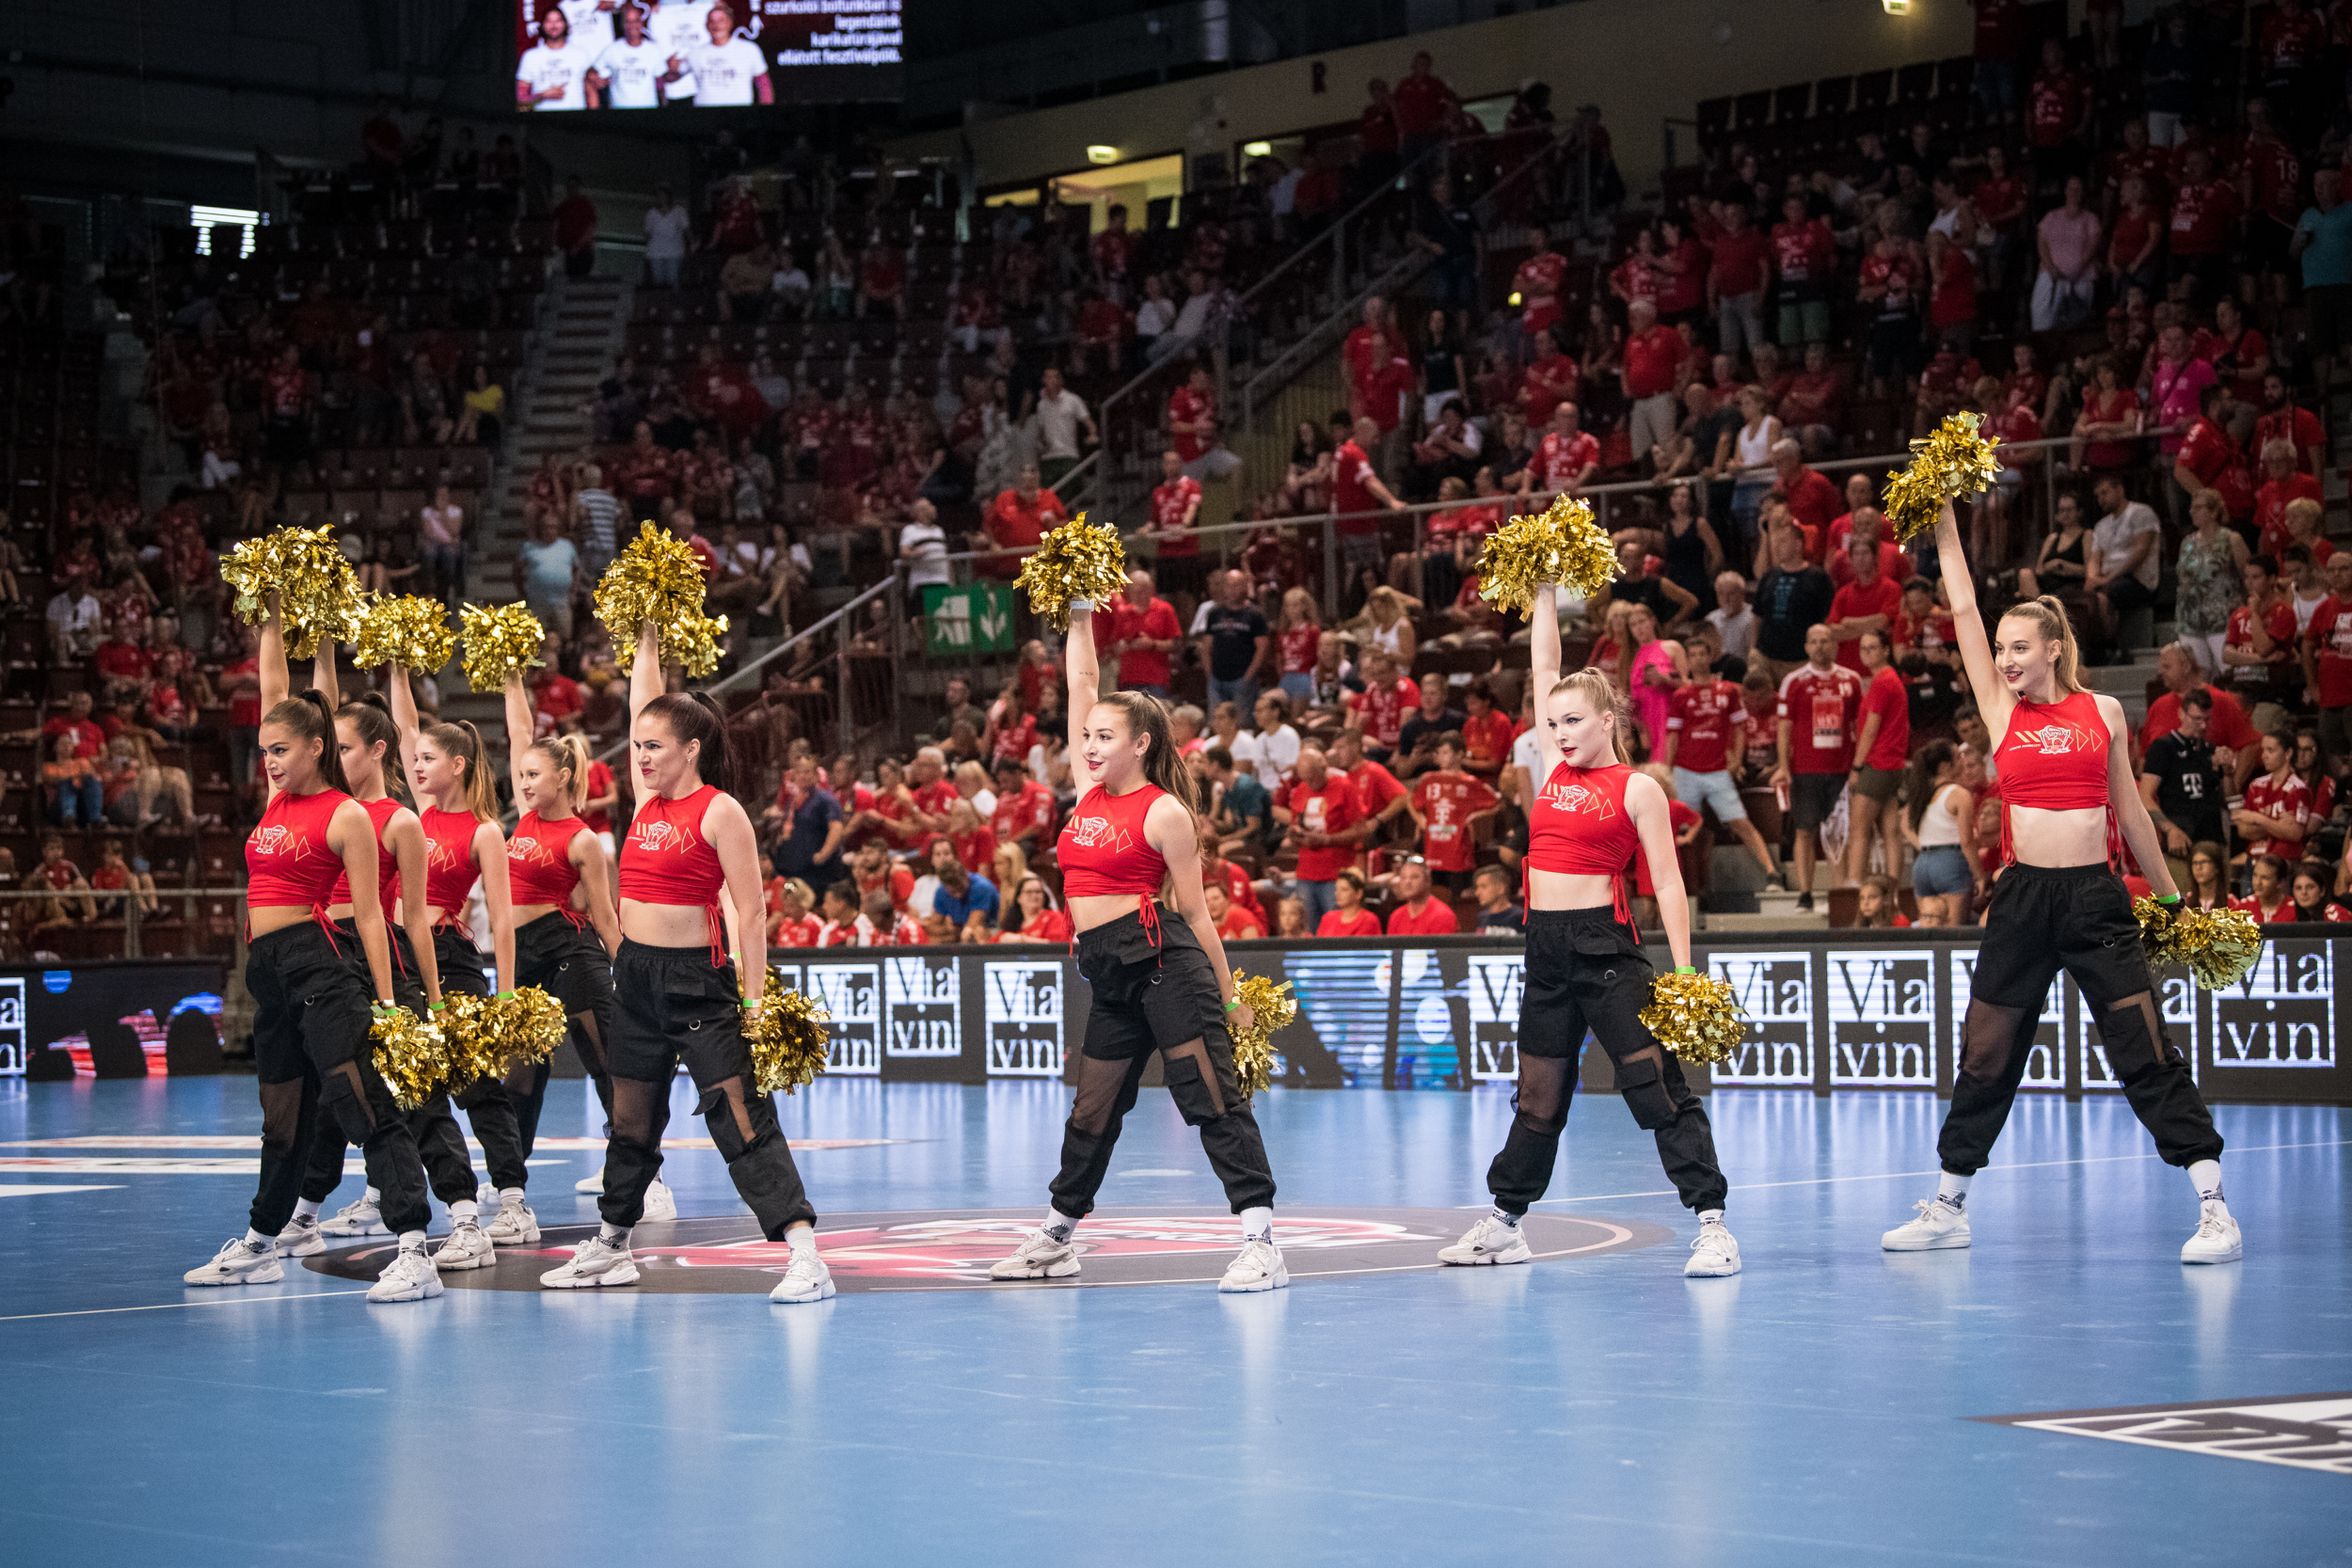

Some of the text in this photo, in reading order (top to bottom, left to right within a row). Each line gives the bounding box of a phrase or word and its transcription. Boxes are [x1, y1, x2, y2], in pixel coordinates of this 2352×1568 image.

[2276, 158, 2300, 184] 18
[815, 973, 875, 1021] Via
[993, 971, 1060, 1022] Via
[1478, 965, 1526, 1021] Vi
[1721, 961, 1807, 1021] Via
[1836, 959, 1930, 1022] Via
[893, 1003, 955, 1051] vin
[993, 1022, 1057, 1069] vin
[1479, 1022, 1519, 1073] vi
[1839, 1022, 1930, 1078] vin
[2225, 999, 2325, 1061] vin
